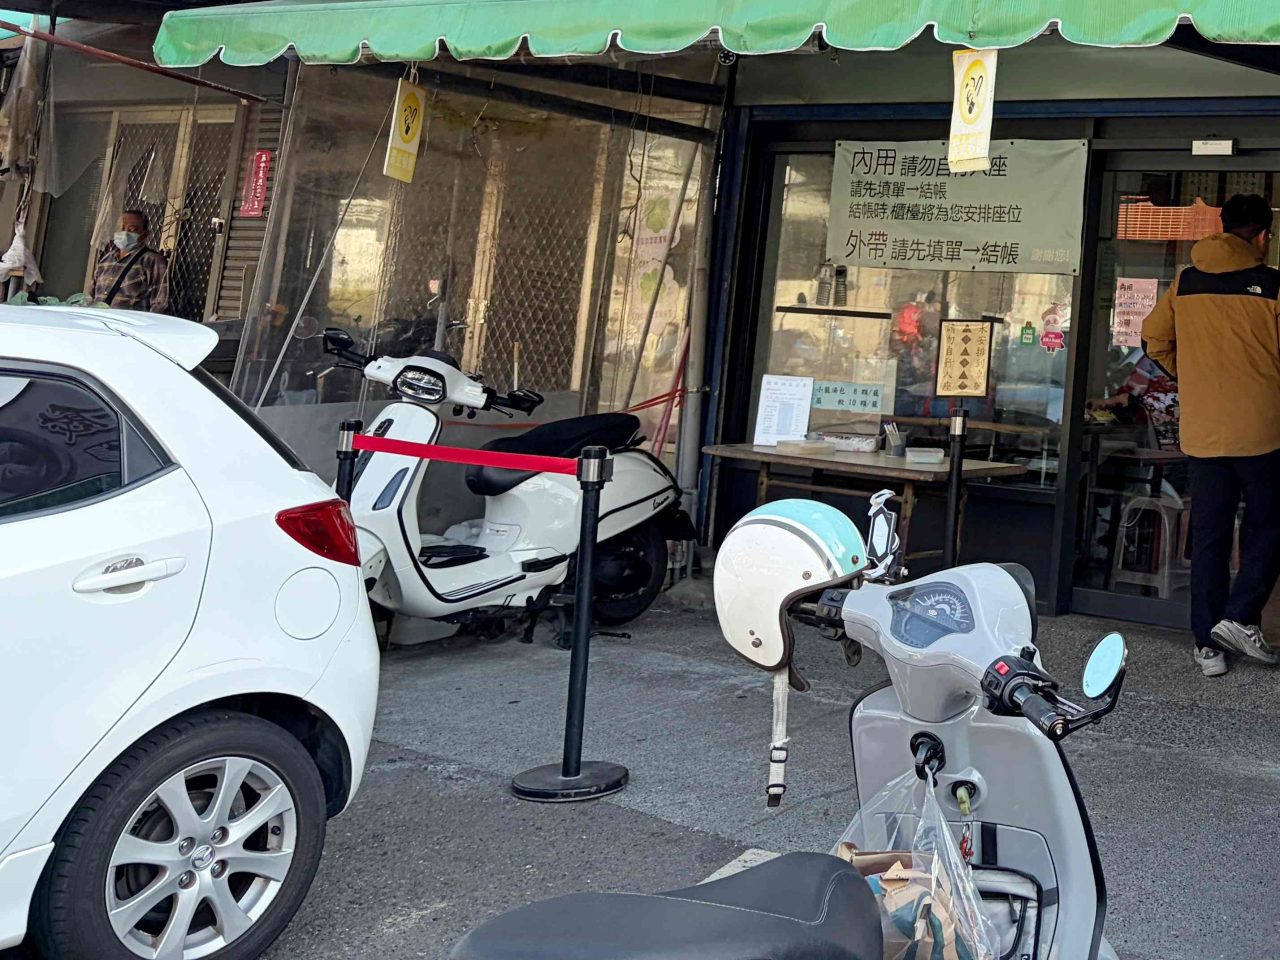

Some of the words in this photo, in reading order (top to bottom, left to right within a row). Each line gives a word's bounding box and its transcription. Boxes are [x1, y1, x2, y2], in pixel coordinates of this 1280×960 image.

[850, 147, 896, 176] 內用
[901, 155, 1008, 177] 請勿自座
[845, 230, 889, 260] 外帶
